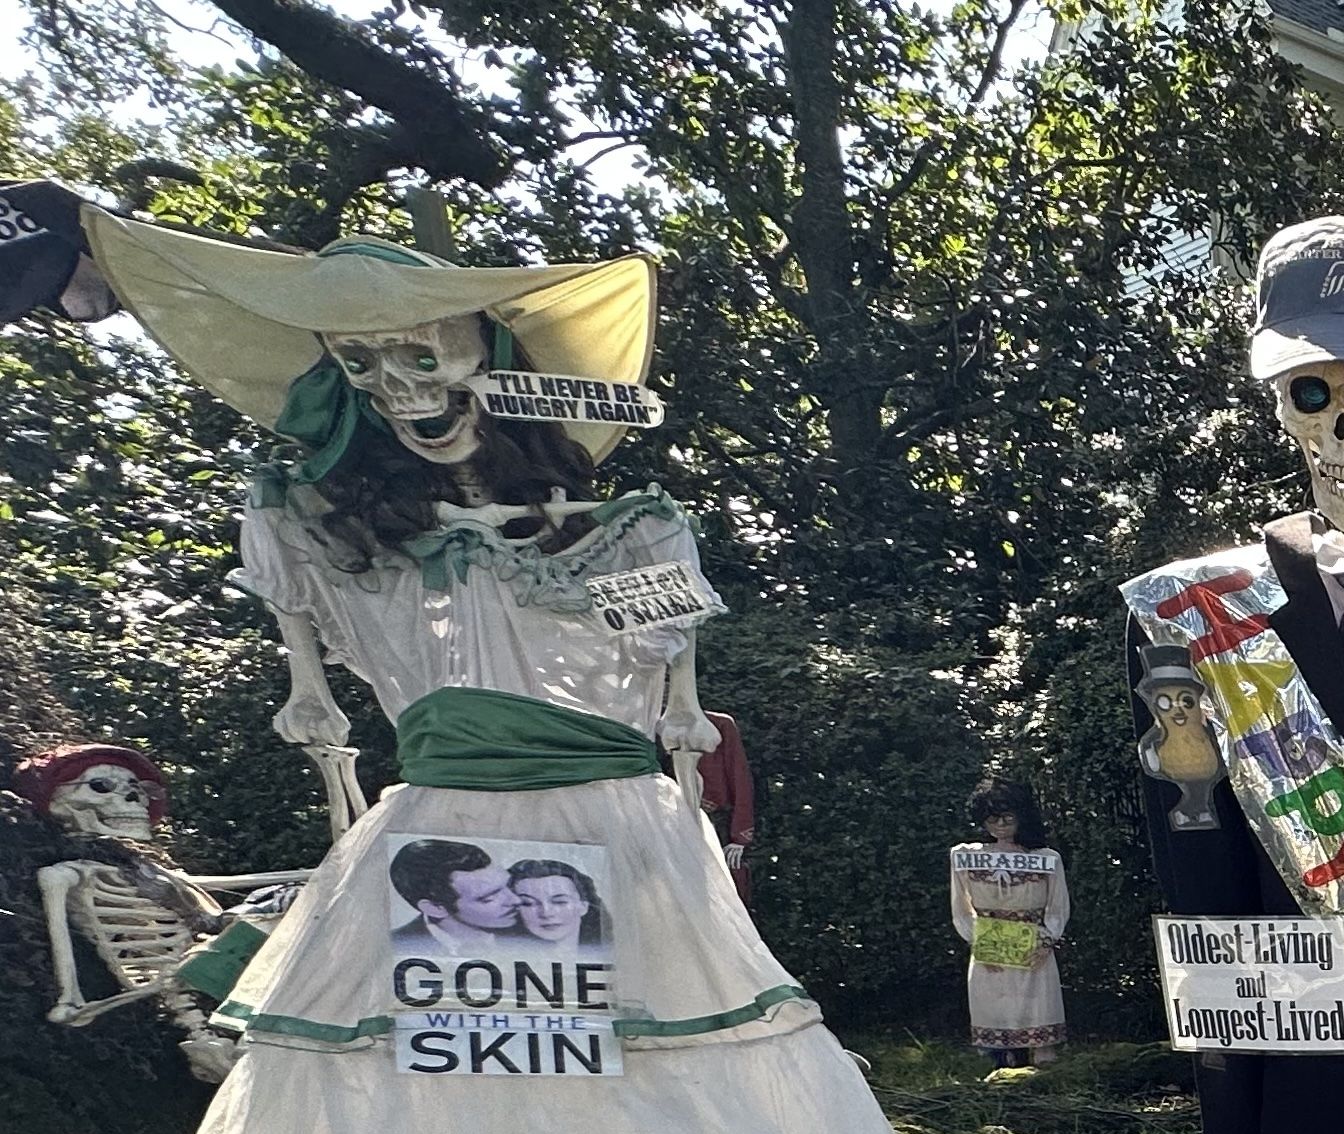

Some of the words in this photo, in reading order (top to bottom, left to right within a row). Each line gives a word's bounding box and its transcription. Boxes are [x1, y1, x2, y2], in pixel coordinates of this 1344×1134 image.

[1290, 249, 1342, 263] ARTER
[539, 376, 609, 400] NEVER
[612, 384, 641, 404] BE
[485, 393, 579, 419] HUNGRY
[956, 852, 1055, 871] MIRABEL
[1168, 923, 1333, 970] Oldest-Living
[393, 958, 613, 1009] GONE
[1235, 971, 1267, 998] and
[425, 1013, 509, 1029] WITH
[526, 1015, 586, 1030] THE
[409, 1031, 602, 1074] SKIN
